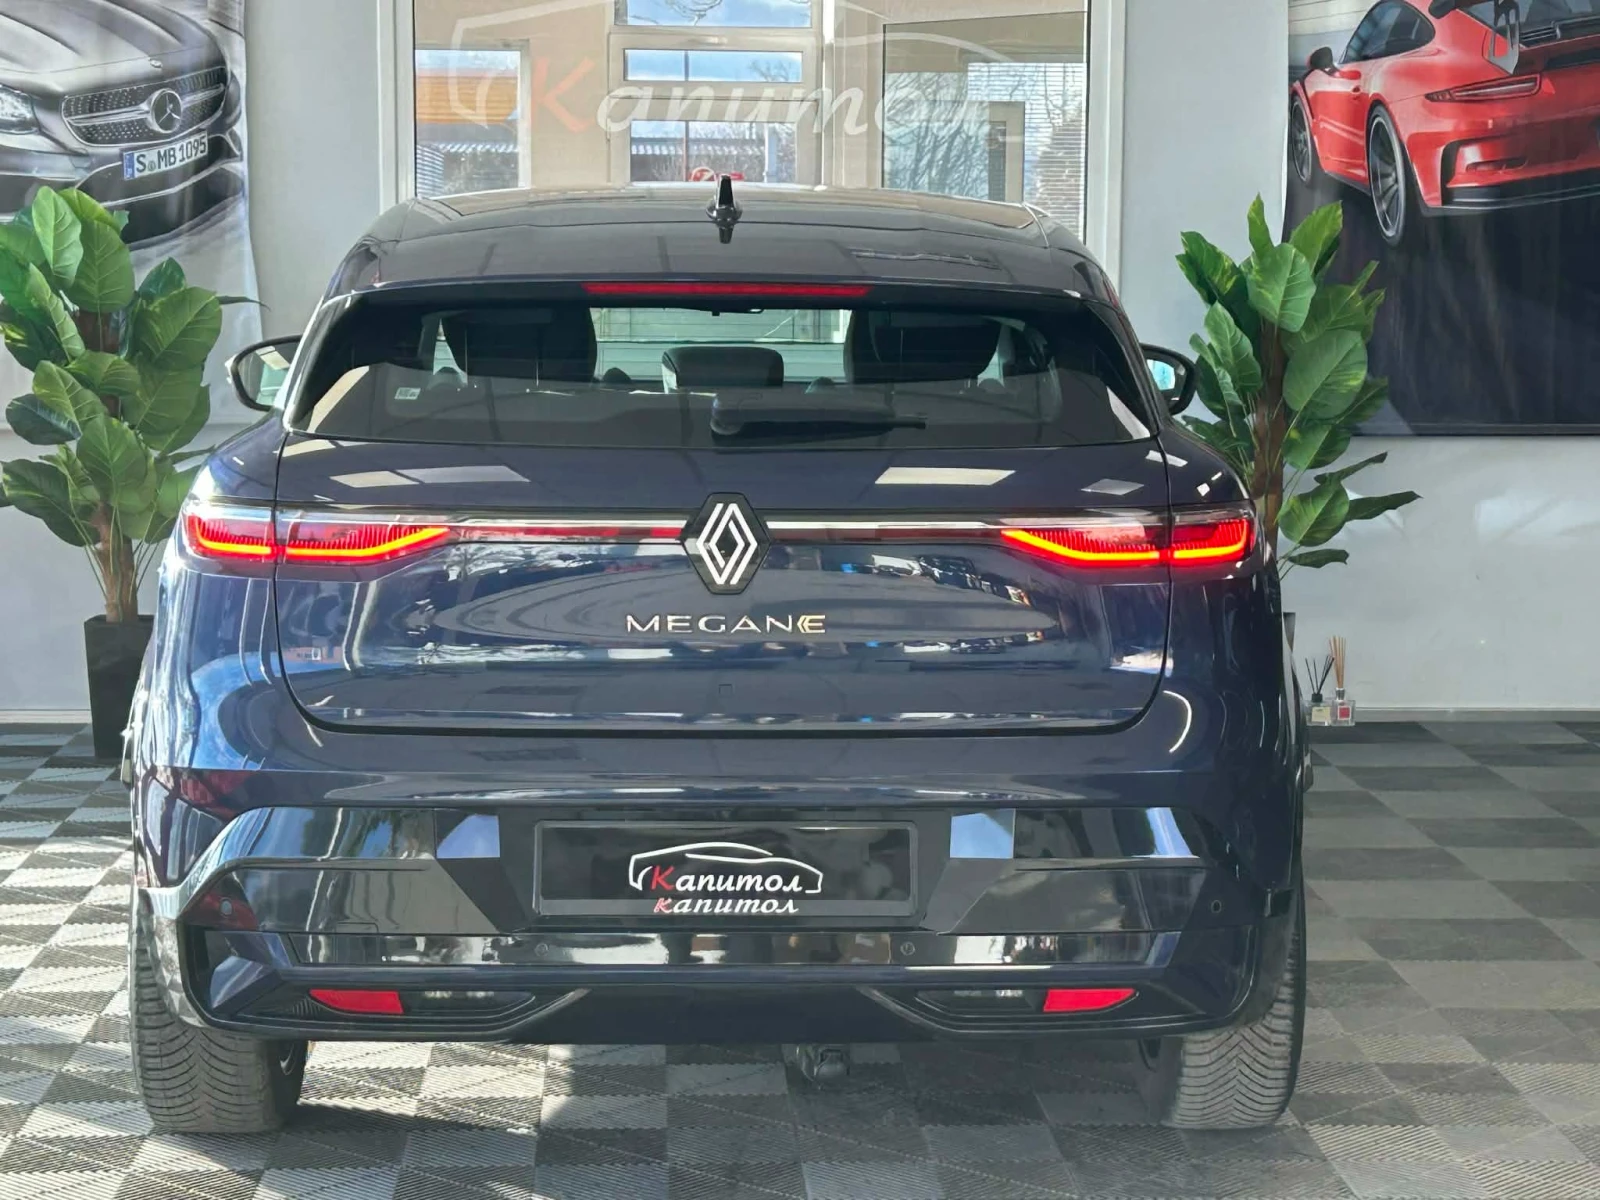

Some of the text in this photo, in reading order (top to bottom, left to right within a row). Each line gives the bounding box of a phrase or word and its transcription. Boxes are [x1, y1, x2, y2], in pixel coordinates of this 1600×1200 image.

[157, 147, 176, 169] MB
[625, 614, 826, 633] MEGANE
[650, 865, 803, 892] Капитол
